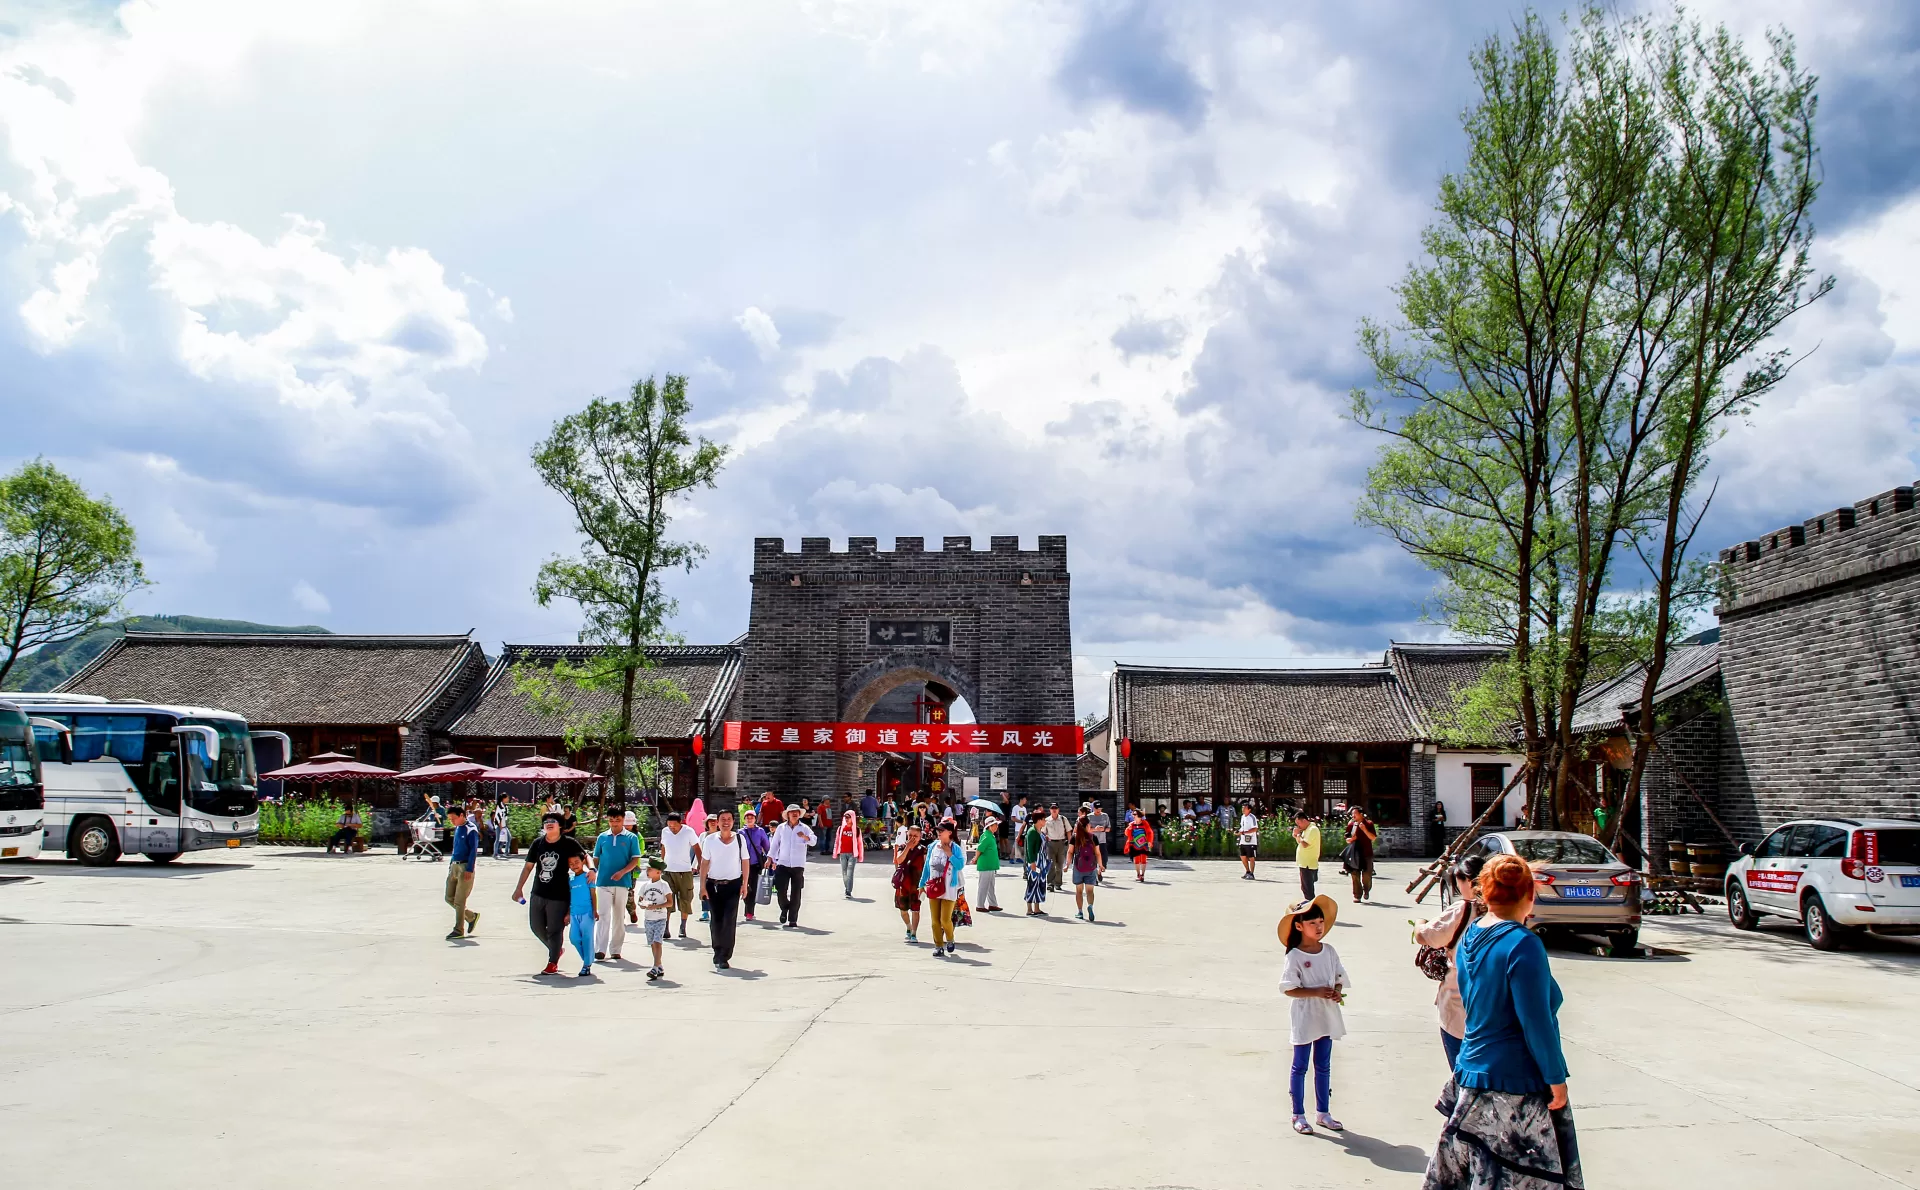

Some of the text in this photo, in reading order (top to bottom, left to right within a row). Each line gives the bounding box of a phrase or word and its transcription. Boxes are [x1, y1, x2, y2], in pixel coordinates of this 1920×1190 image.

[750, 727, 1054, 747] 走皇家御道赏木兰风光
